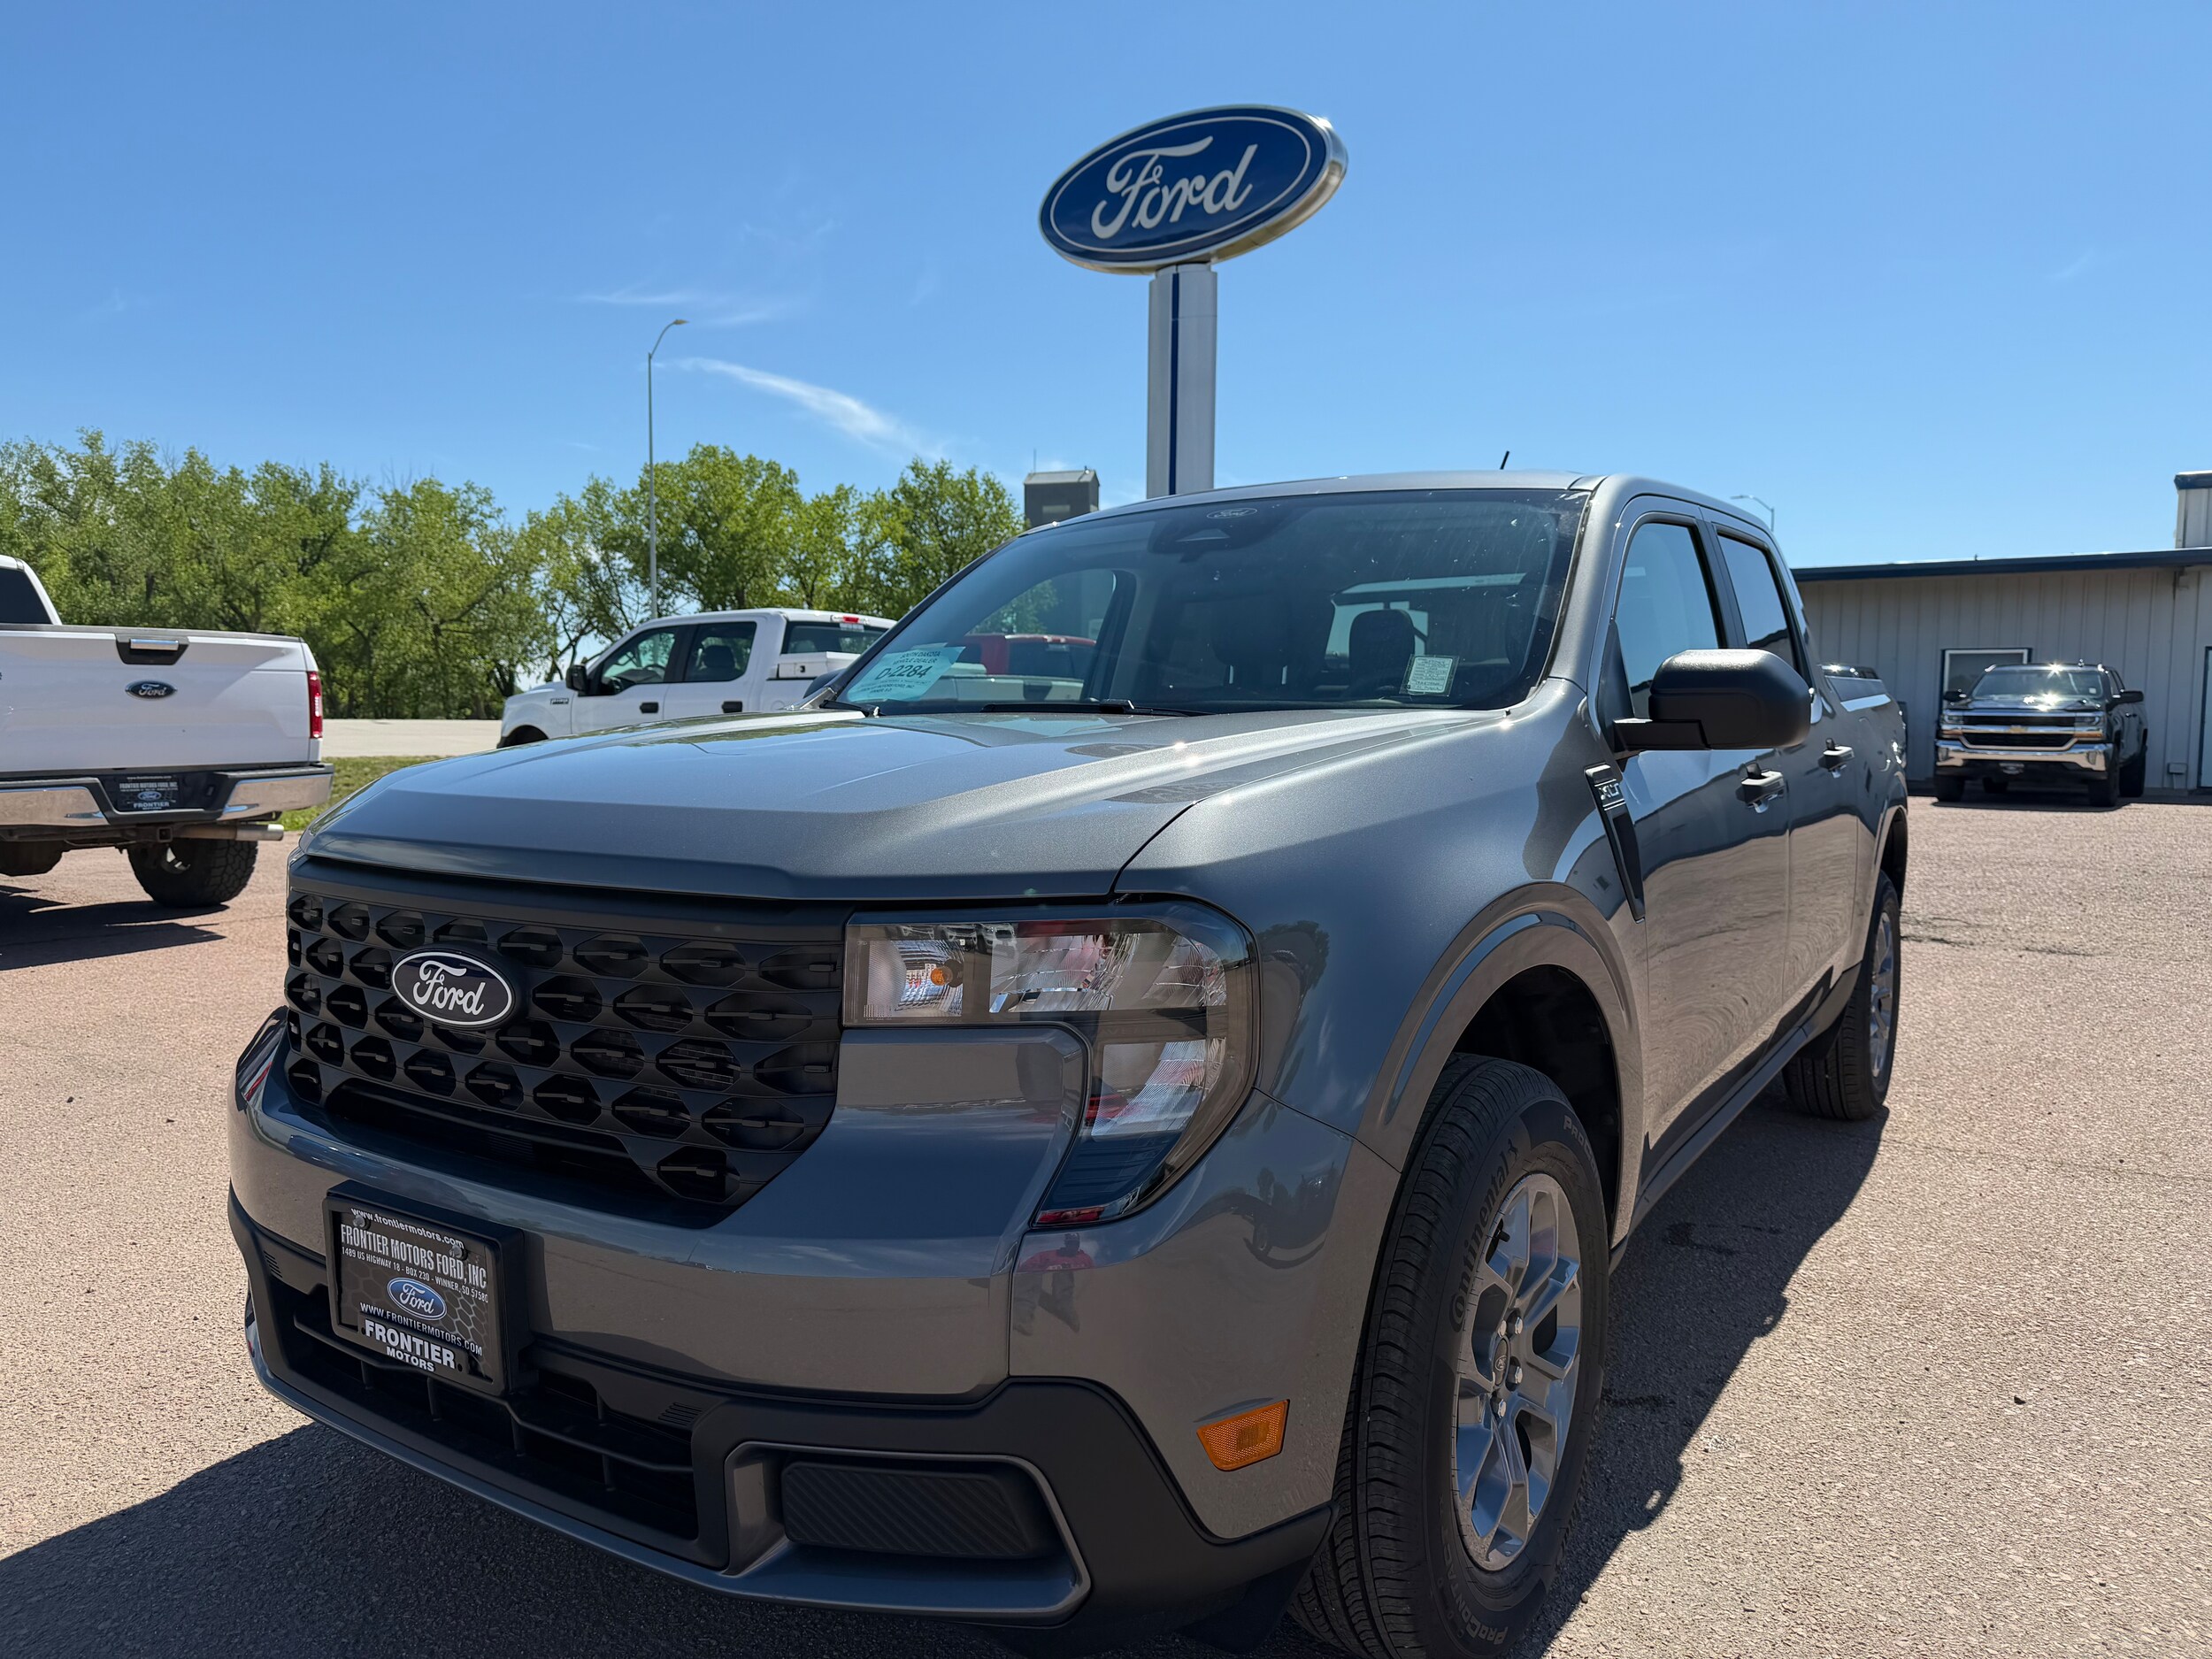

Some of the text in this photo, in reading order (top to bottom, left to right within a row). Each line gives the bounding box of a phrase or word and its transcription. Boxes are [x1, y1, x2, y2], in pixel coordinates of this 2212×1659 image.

[1091, 136, 1258, 239] Ford
[138, 683, 167, 696] Ford
[875, 664, 933, 680] D-2284
[1599, 782, 1620, 800] XLT
[412, 960, 486, 1015] Ford
[341, 1224, 389, 1256] FRONTIER
[390, 1239, 434, 1271] MOTORS
[357, 1250, 365, 1261] US
[365, 1253, 392, 1268] HIGHWAY
[405, 1266, 418, 1278] BOX
[419, 1270, 430, 1281] 230
[461, 1285, 470, 1295] SD
[399, 1283, 434, 1314] Ford
[359, 1302, 483, 1356] WWW.FRONTIERMOTORS.COM
[365, 1319, 456, 1369] FRONTIER
[386, 1346, 435, 1371] MOTORS
